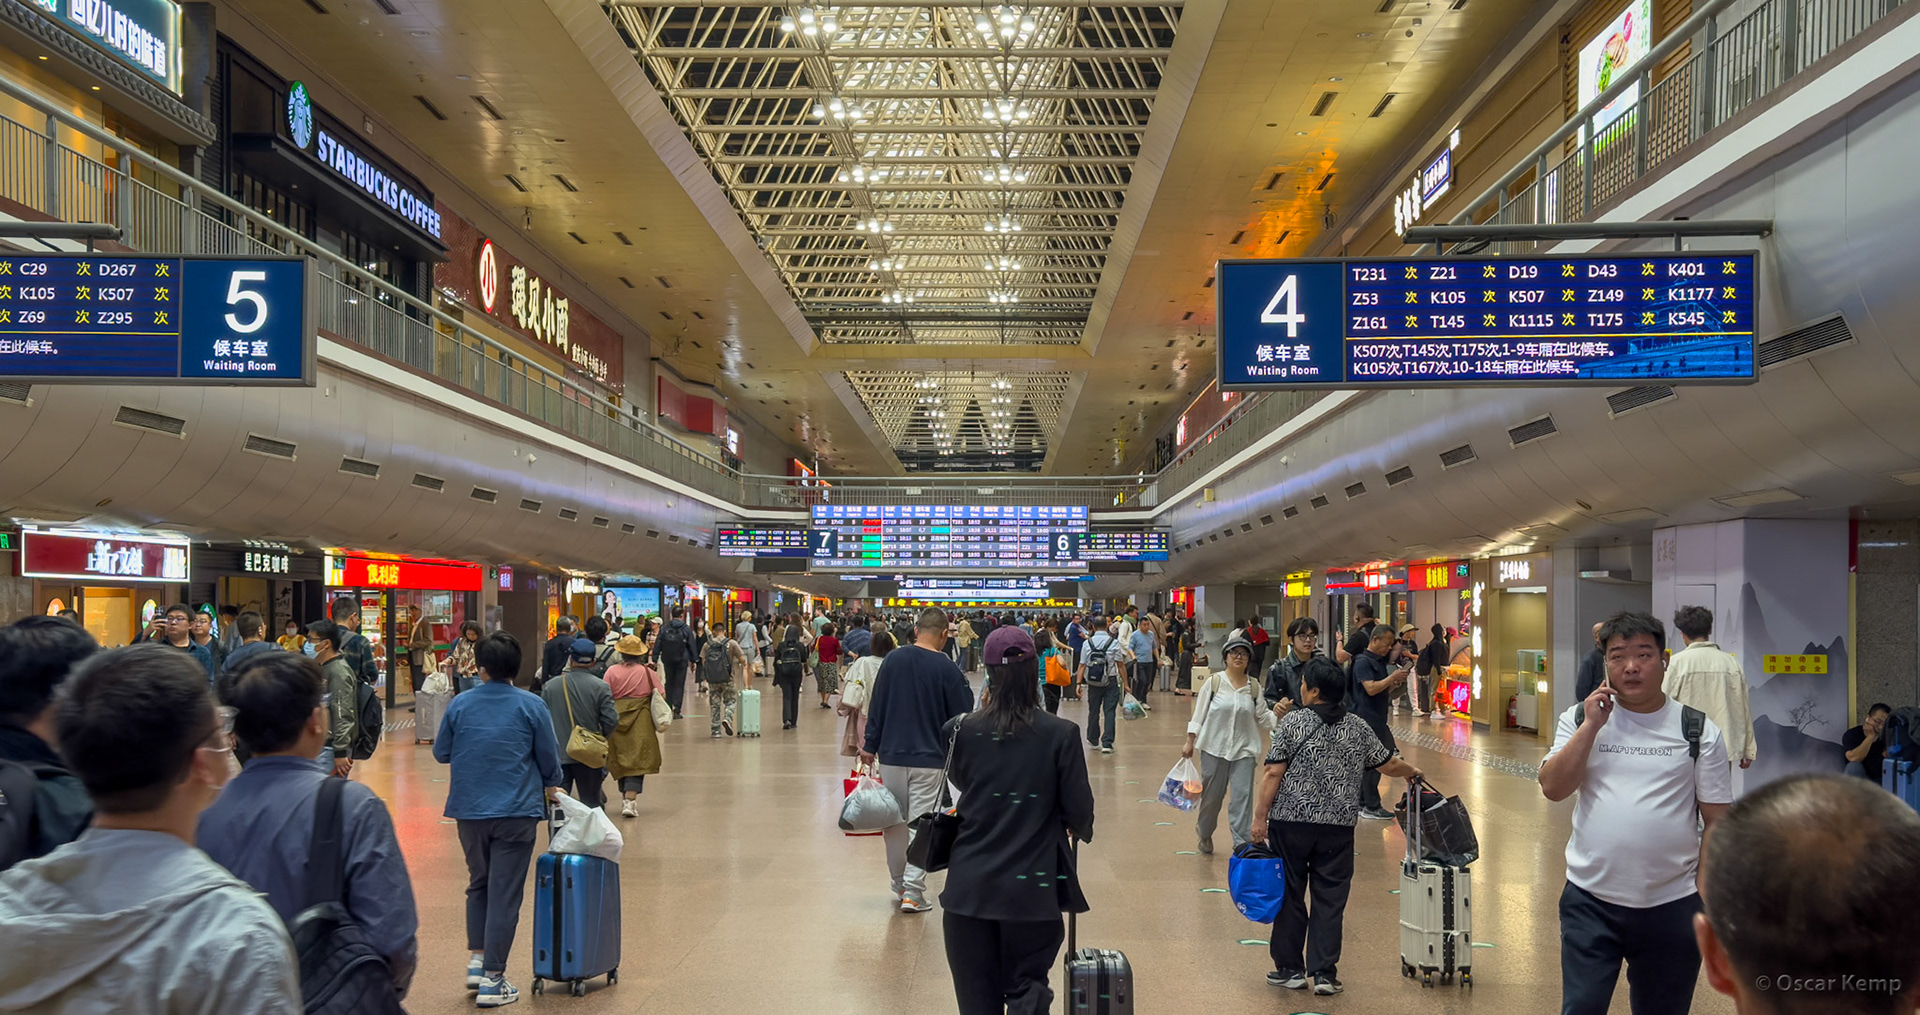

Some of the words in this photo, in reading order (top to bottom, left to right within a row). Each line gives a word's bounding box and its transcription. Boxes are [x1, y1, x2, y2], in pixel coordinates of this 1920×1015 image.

[318, 131, 398, 210] STARBUCKS
[399, 189, 441, 239] COFFEE
[20, 263, 47, 275] C29
[77, 262, 91, 276] 次
[99, 264, 136, 276] D267
[155, 263, 170, 277] 次
[1353, 268, 1387, 281] T231
[1404, 266, 1418, 279] 次
[1430, 267, 1457, 280] Z21
[1483, 265, 1496, 278] 次
[1509, 266, 1537, 279] D19
[1562, 264, 1576, 277] 次
[1588, 265, 1617, 277] D43
[1642, 263, 1655, 276] 次
[1669, 263, 1705, 276] K401
[1723, 261, 1737, 274] 次
[19, 287, 55, 300] K105
[76, 286, 91, 300] 次
[98, 288, 134, 301] K507
[154, 287, 169, 301] 次
[225, 271, 268, 334] 5
[1353, 293, 1379, 305] Z53
[1404, 291, 1418, 304] 次
[1431, 291, 1466, 304] K105
[1483, 290, 1496, 303] 次
[1509, 291, 1545, 303] K507
[1562, 289, 1576, 302] 次
[1588, 290, 1624, 302] Z149
[1642, 288, 1655, 301] 次
[1669, 288, 1714, 301] K1177
[1723, 287, 1737, 300] 次
[511, 265, 569, 355] 遇见小面
[1260, 274, 1306, 338] 4
[19, 311, 45, 323] Z69
[75, 310, 90, 324] 次
[97, 312, 133, 324] Z295
[153, 311, 168, 325] 次
[1353, 317, 1388, 330] Z161
[1404, 315, 1418, 328] 次
[1430, 315, 1465, 328] T145
[1483, 314, 1496, 327] 次
[1509, 314, 1554, 327] K1115
[1562, 313, 1576, 326] 次
[1588, 313, 1623, 326] T175
[1642, 312, 1655, 325] 次
[1669, 312, 1705, 325] K545
[1723, 310, 1737, 323] 次
[213, 339, 268, 358] 候车室
[1256, 344, 1311, 362] 候车室
[203, 360, 244, 373] Waiting
[248, 360, 277, 372] Room
[1247, 366, 1287, 377] Waiting
[1291, 365, 1319, 376] Room
[819, 532, 831, 548] 7
[1057, 534, 1069, 550] 6
[244, 552, 289, 574] 星巴克咖啡
[367, 563, 400, 586] 便利店
